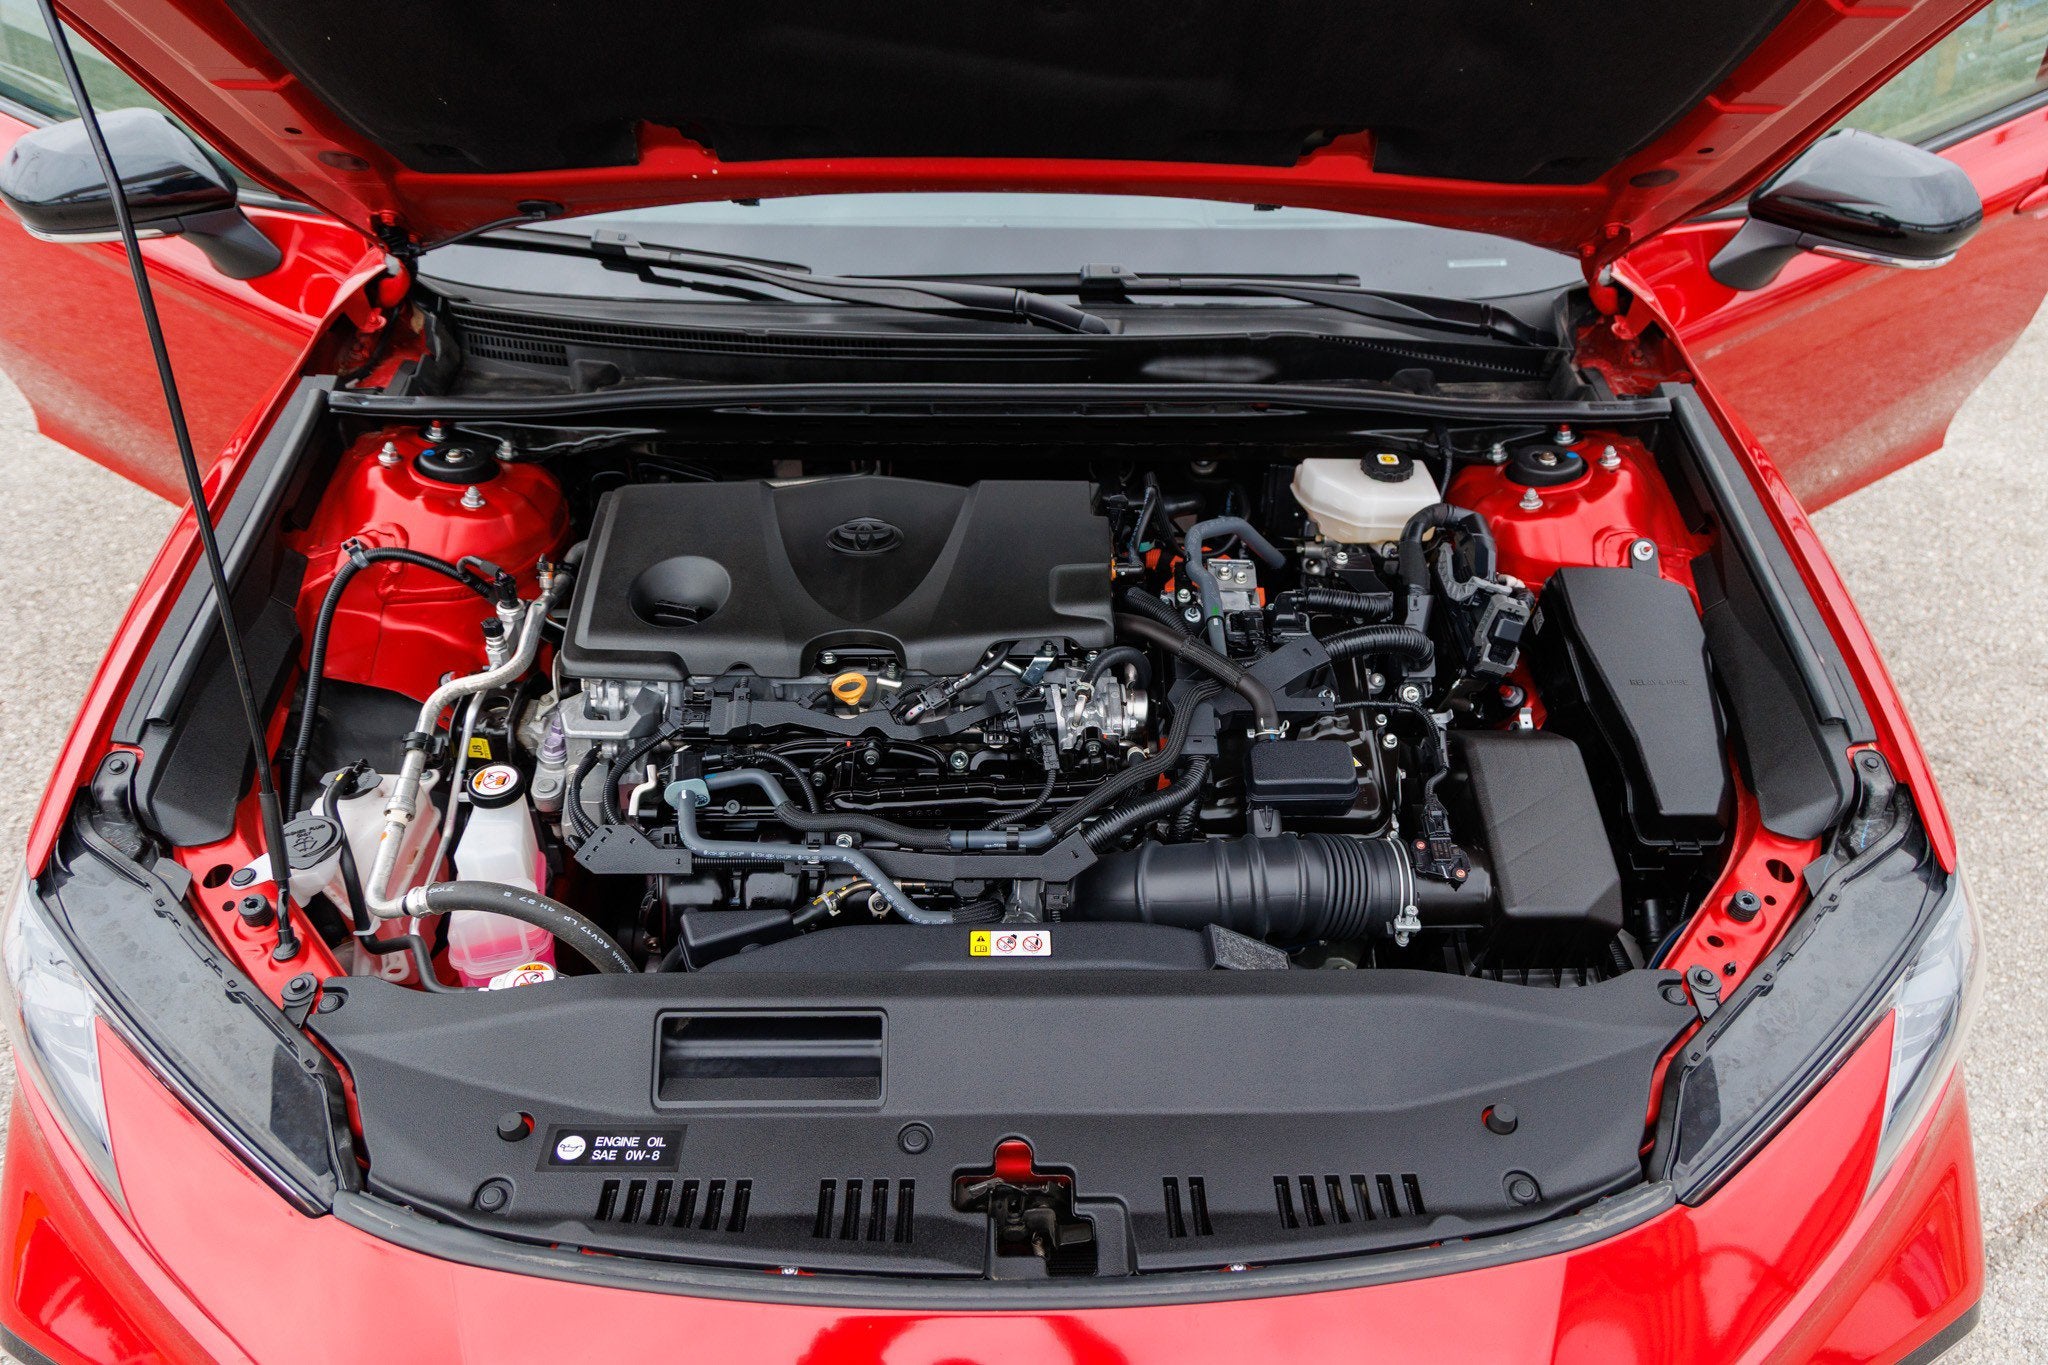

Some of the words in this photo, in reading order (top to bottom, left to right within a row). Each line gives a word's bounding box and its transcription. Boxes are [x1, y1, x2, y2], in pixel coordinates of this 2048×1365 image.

[594, 1136, 640, 1147] ENGINE
[646, 1136, 667, 1147] OIL
[591, 1149, 617, 1161] SAE
[625, 1149, 661, 1161] 0W-8
